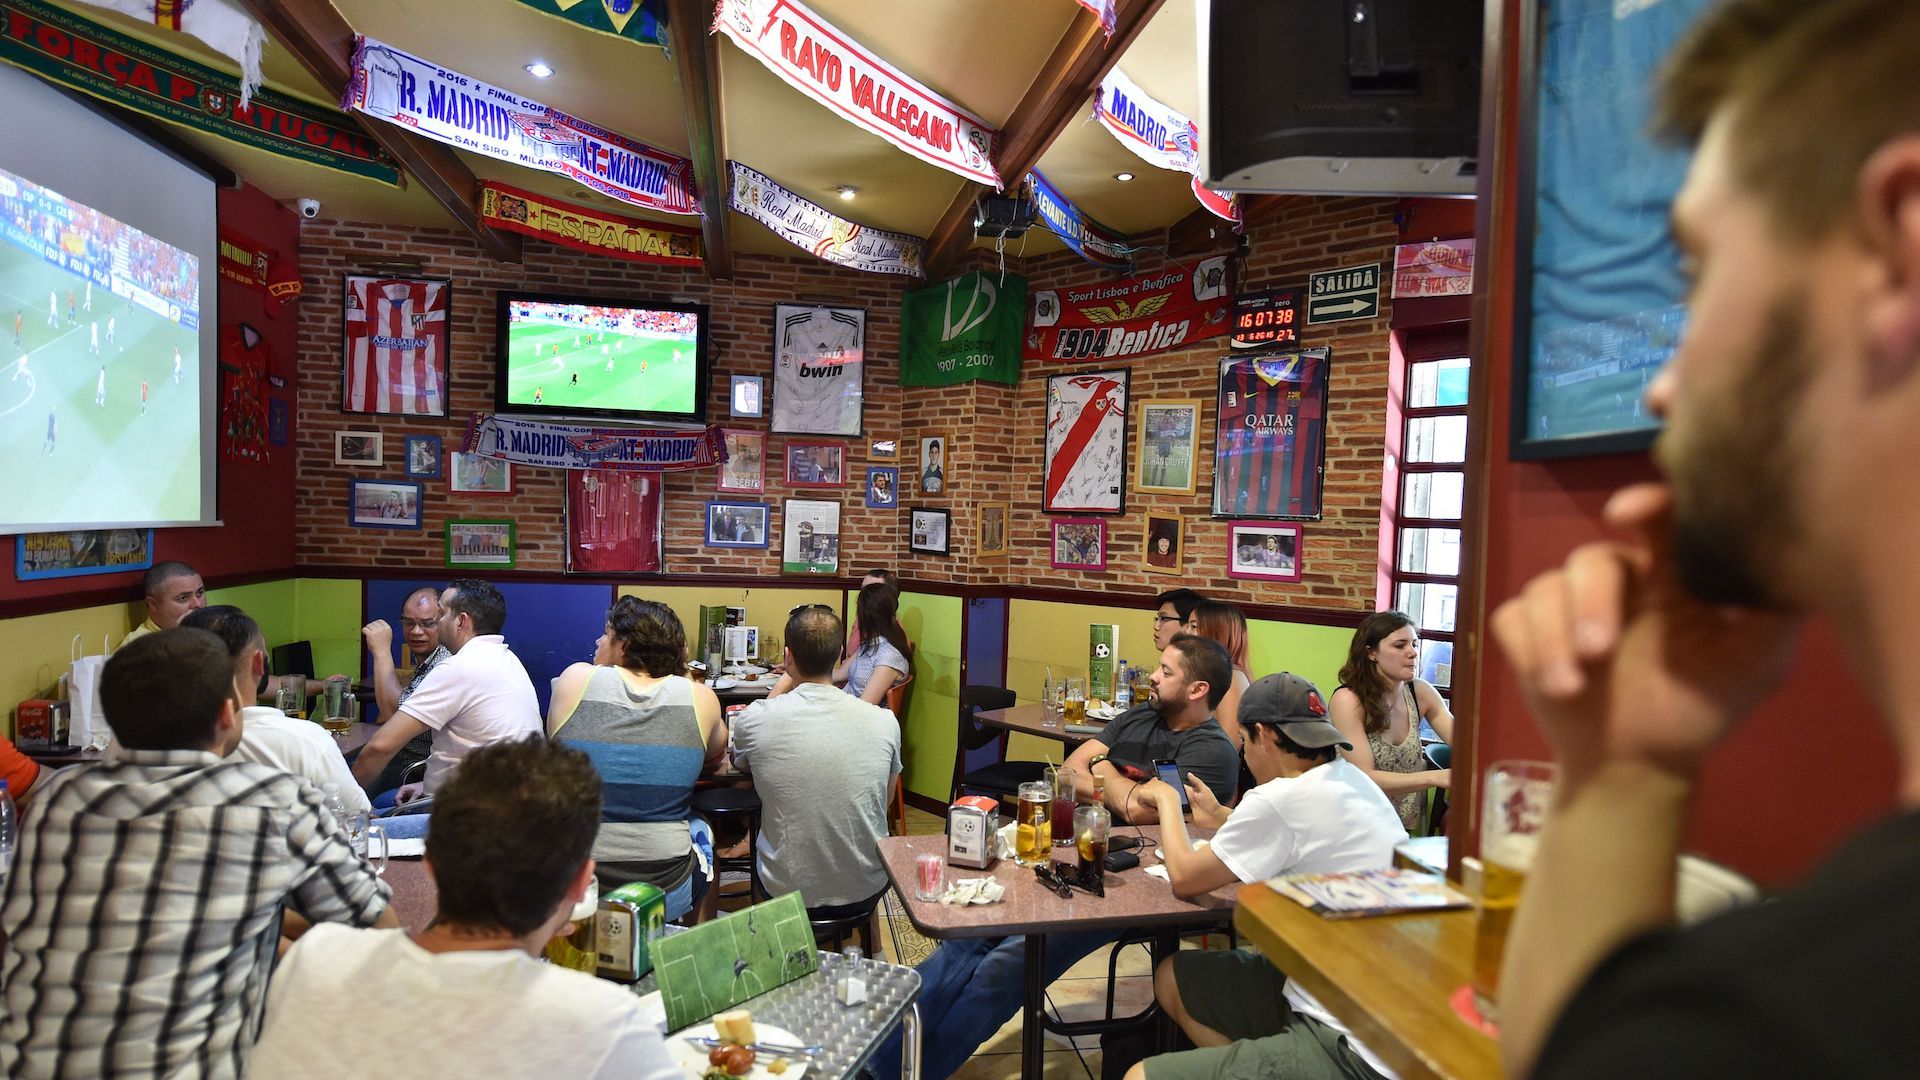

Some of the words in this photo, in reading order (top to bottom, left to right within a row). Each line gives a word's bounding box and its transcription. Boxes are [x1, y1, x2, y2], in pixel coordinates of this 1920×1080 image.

[9, 10, 159, 95] FORÇA
[170, 75, 369, 158] PRTUGAL
[780, 19, 843, 93] RAYO
[849, 65, 952, 153] VALLECANO
[437, 70, 468, 87] 2016
[487, 88, 519, 105] FINAL
[521, 99, 551, 115] COPA
[553, 111, 567, 123] DE
[569, 120, 610, 140] EUROPA
[1111, 86, 1168, 152] MADRID
[400, 70, 421, 114] R.
[427, 80, 510, 142] MADRID
[579, 137, 604, 177] AT.
[606, 147, 670, 196] MADRID
[454, 135, 479, 151] SAN
[482, 144, 510, 158] SIRO
[519, 153, 563, 170] MILANO
[22, 190, 35, 203] ESP
[1038, 190, 1067, 232] LEVANTE
[760, 190, 791, 221] Real
[787, 210, 826, 239] Madrid
[540, 208, 663, 257] ESPAÑA
[851, 235, 874, 258] Real
[872, 244, 904, 259] Madrid
[1067, 291, 1094, 303] Sport
[1097, 286, 1130, 300] Lisboa
[1132, 285, 1139, 294] e
[1142, 272, 1184, 292] Benfica
[1315, 269, 1375, 295] SALIDA
[1274, 300, 1291, 308] zero
[372, 335, 429, 349] AZERBAIJAN
[1052, 328, 1111, 359] 1904
[1103, 319, 1191, 358] Benfica
[799, 362, 843, 378] bwin
[936, 358, 957, 373] 1907
[965, 353, 995, 368] 2007
[549, 425, 573, 433] FINAL
[1244, 413, 1294, 429] QATAR
[1256, 427, 1294, 436] AIRWAYS
[496, 427, 509, 452] R.
[510, 429, 566, 458] MADRID
[619, 438, 641, 461] AT.
[642, 438, 697, 462] MADRID
[1144, 457, 1165, 467] JOHAN
[1165, 457, 1189, 467] CRUYFF
